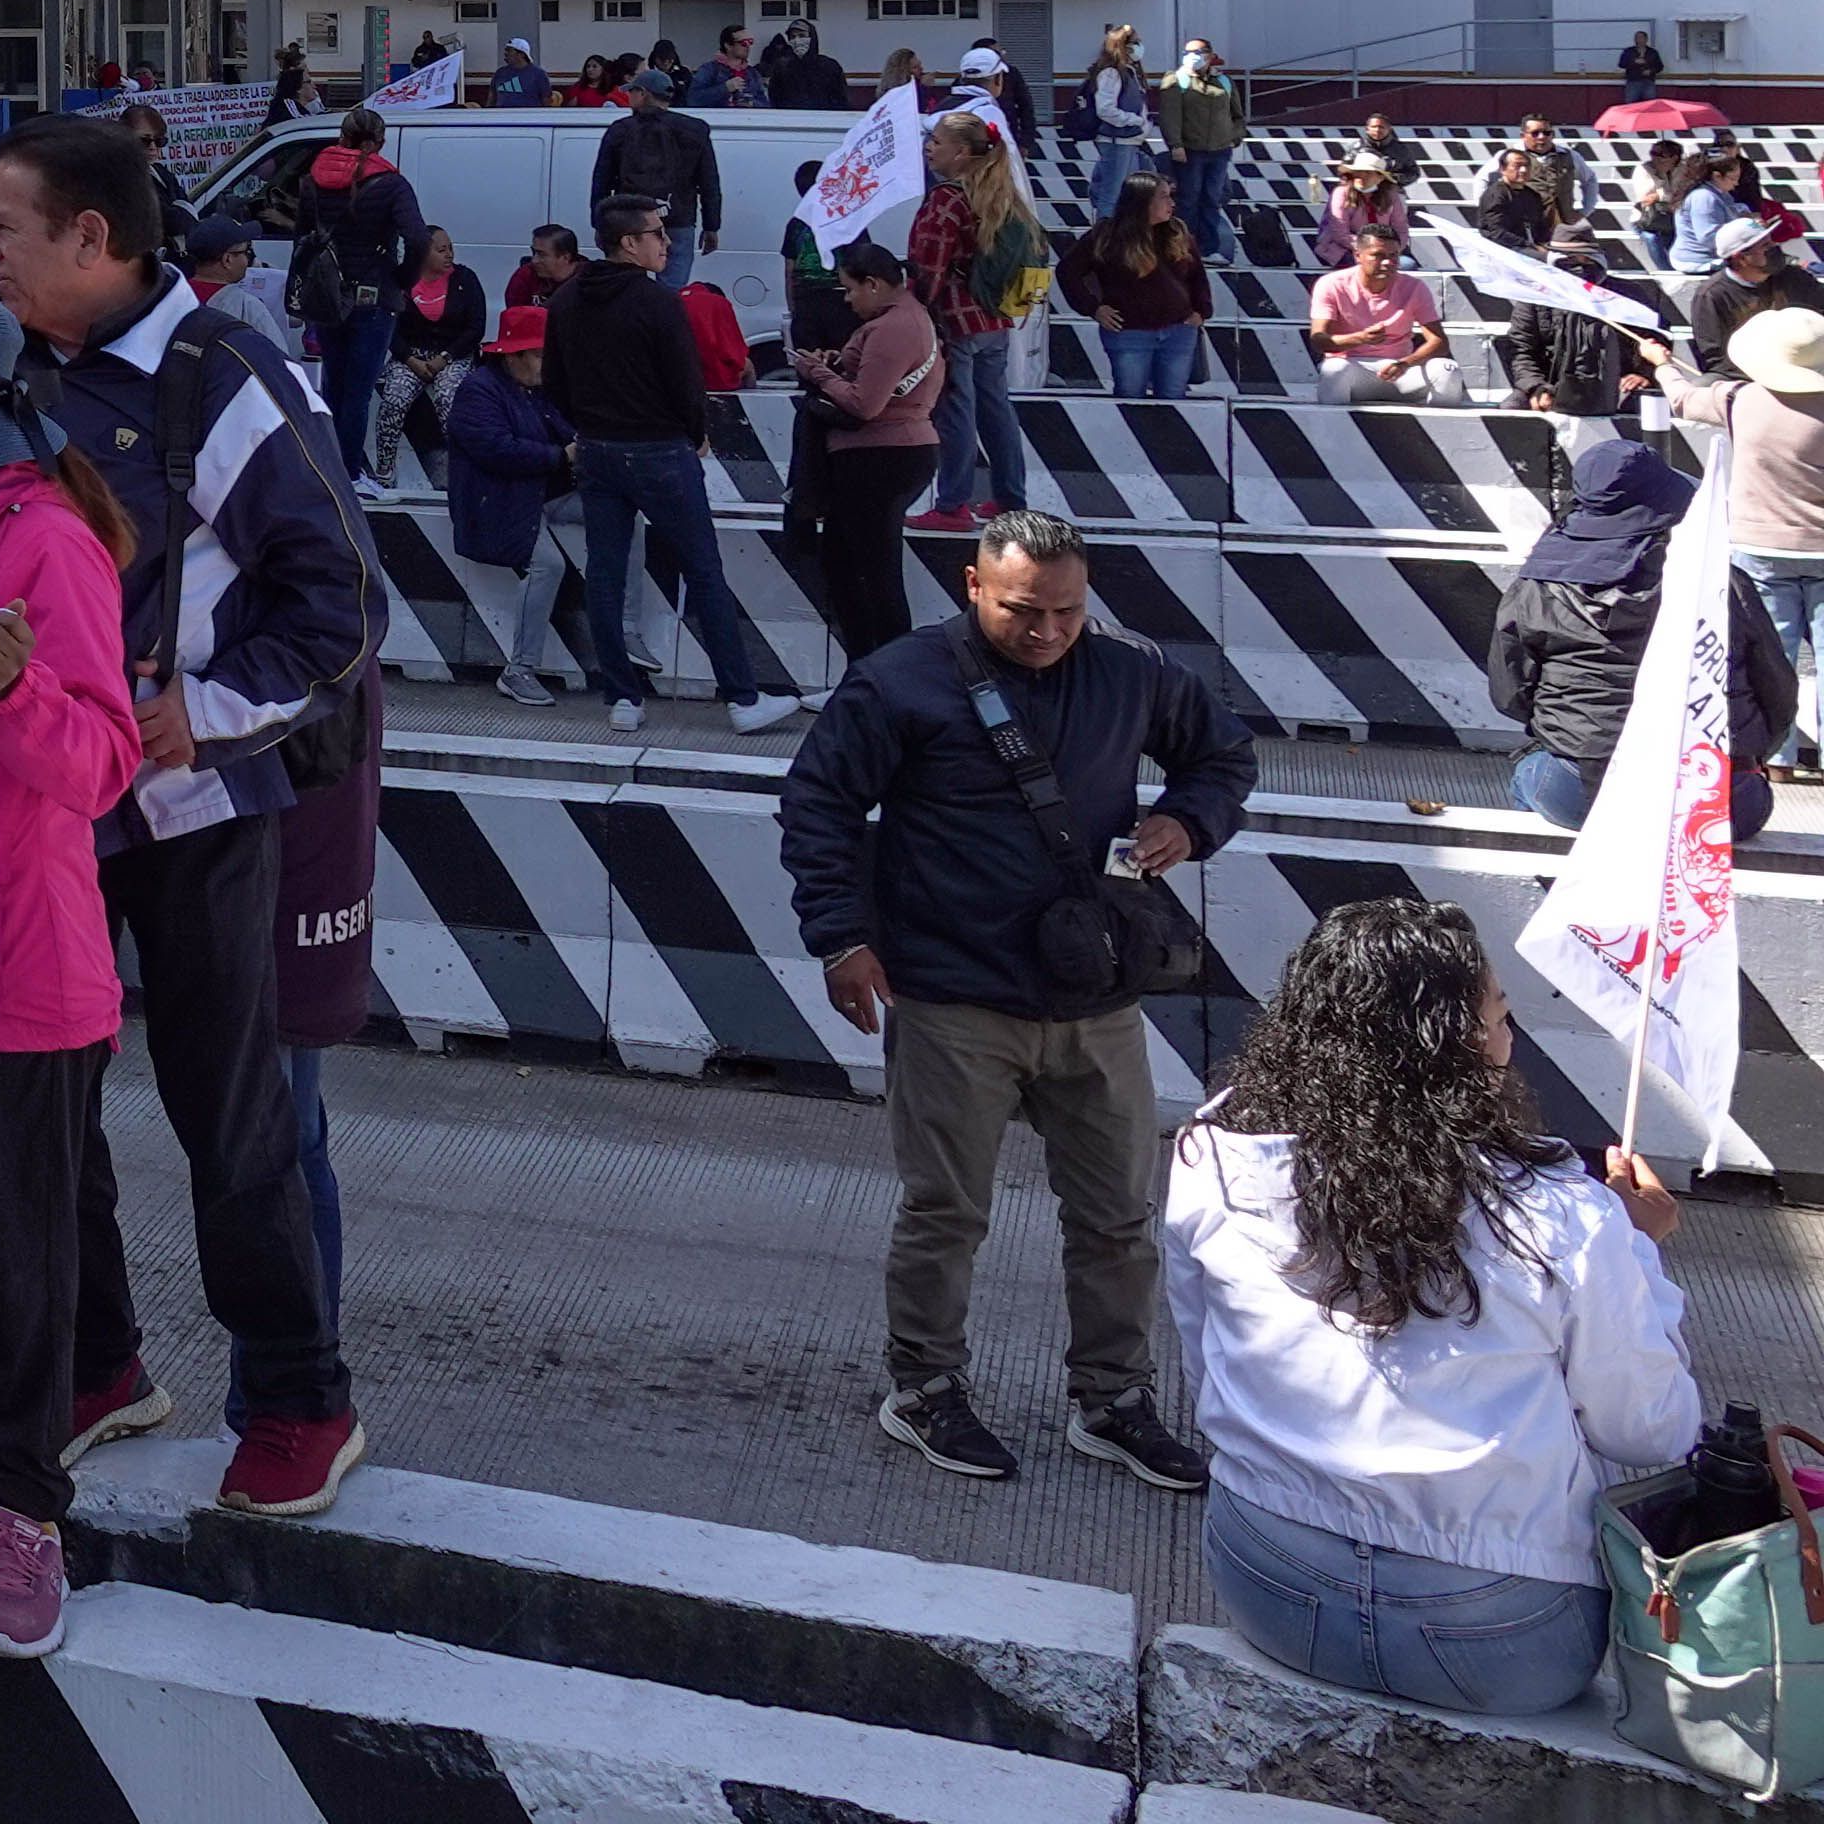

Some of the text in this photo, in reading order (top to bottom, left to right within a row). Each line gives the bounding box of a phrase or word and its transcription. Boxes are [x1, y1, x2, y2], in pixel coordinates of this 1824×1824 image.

[173, 93, 183, 104] DE
[184, 88, 239, 103] TRABAJADORES
[240, 88, 250, 99] DE
[251, 87, 260, 98] LA
[211, 115, 216, 123] Y
[170, 127, 227, 143] LA REFORMA
[168, 146, 182, 160] DE
[184, 145, 198, 159] LA
[200, 143, 217, 157] LEY
[297, 898, 367, 948] LASER
